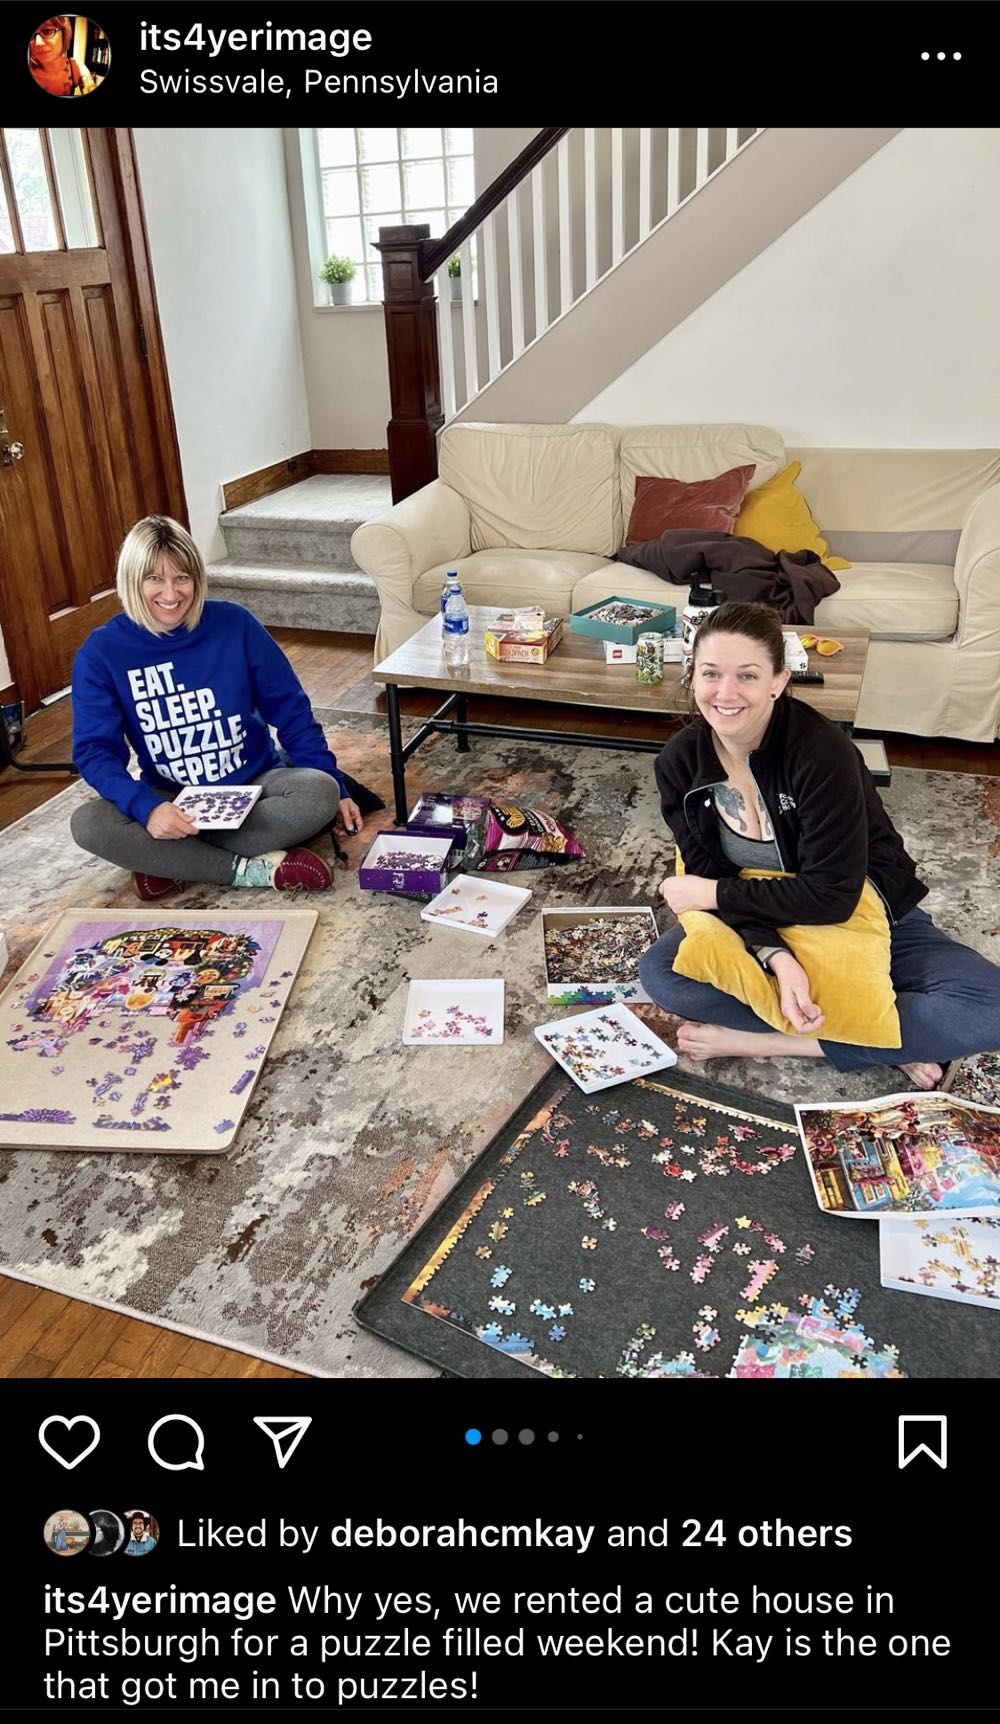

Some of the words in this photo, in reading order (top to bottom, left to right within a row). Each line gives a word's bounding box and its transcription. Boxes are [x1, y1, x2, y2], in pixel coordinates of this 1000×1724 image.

[127, 661, 185, 701] EAT.
[135, 687, 222, 733] SLEEP.
[144, 714, 247, 763] PUZZLE.
